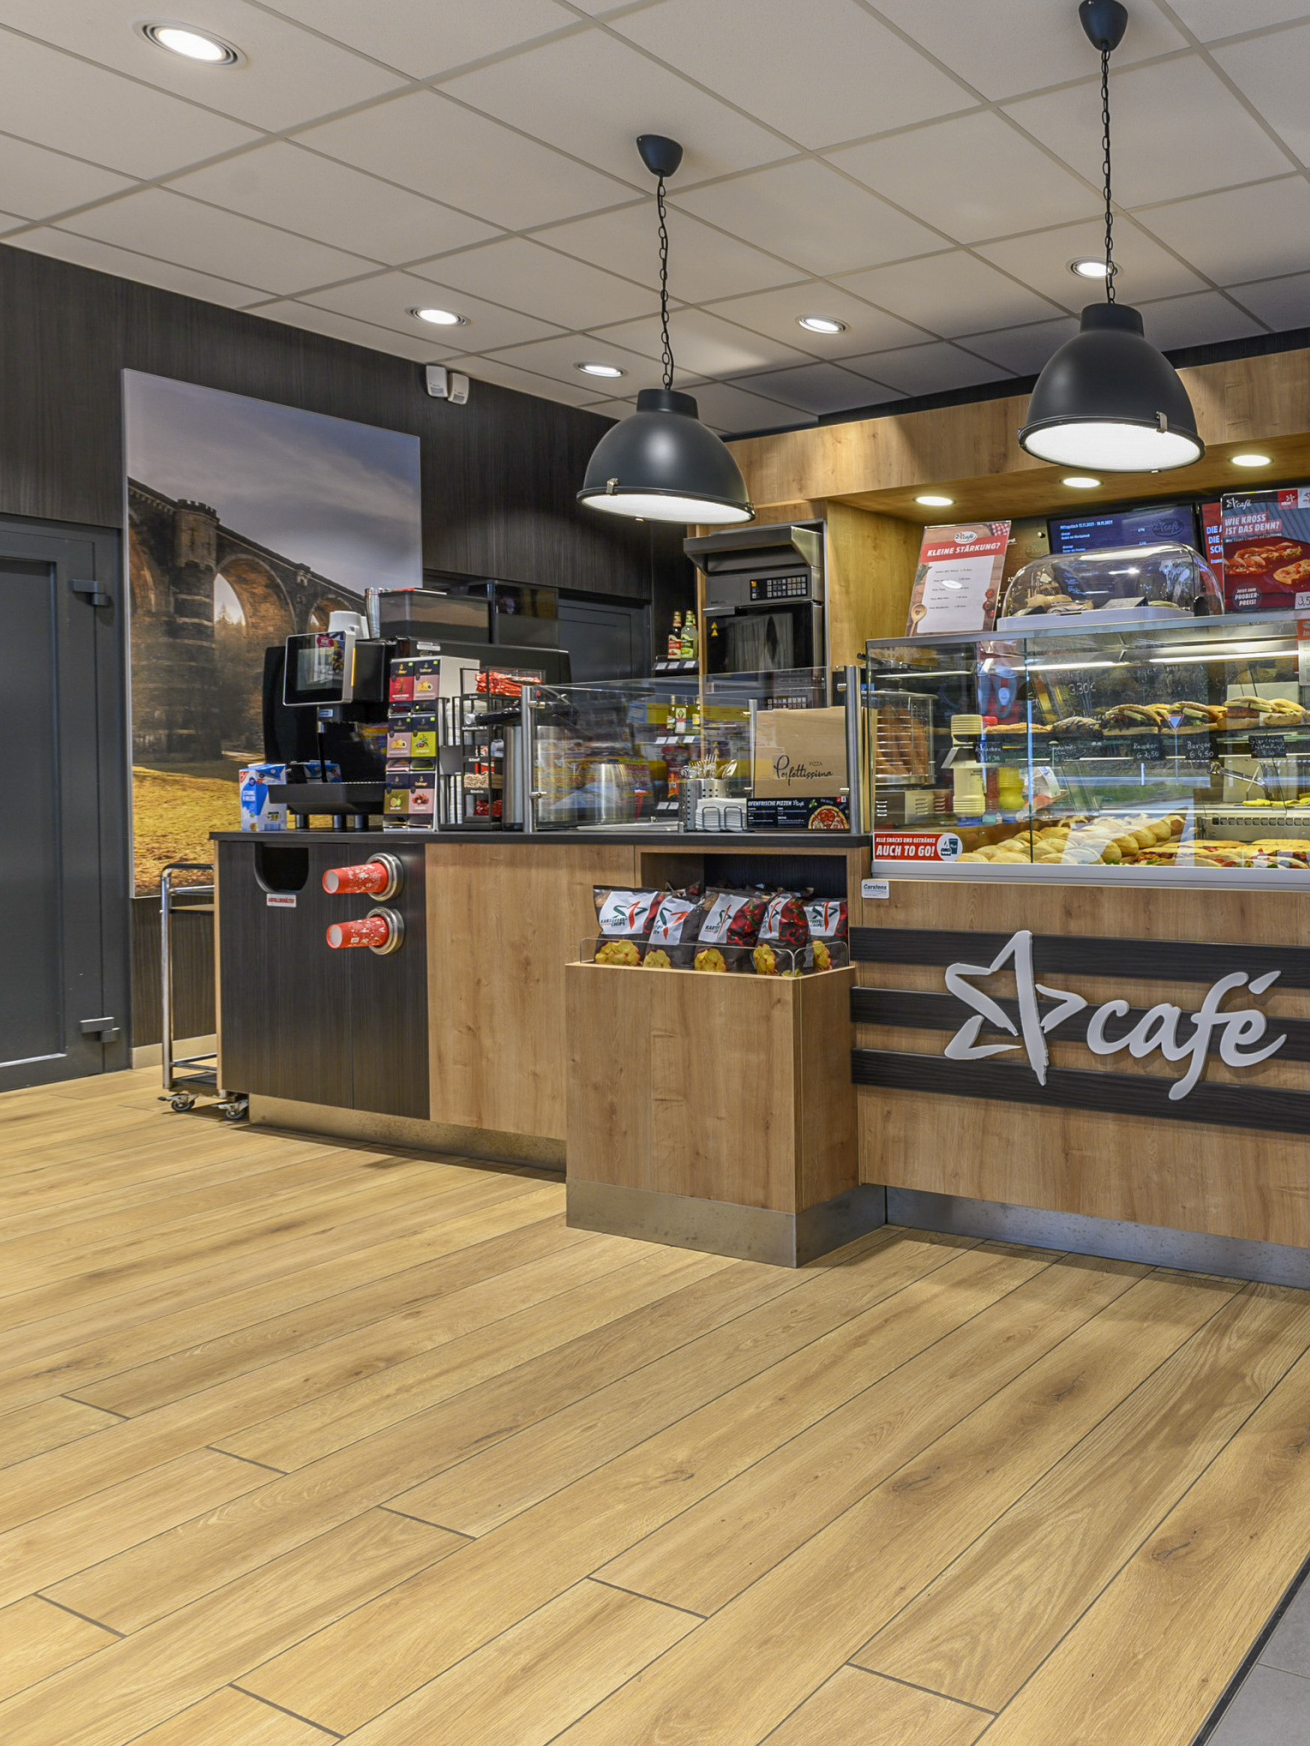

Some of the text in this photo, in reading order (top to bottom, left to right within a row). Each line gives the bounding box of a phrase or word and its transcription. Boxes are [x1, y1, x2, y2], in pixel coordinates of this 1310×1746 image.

[1225, 513, 1266, 527] WIE KROSS
[1206, 525, 1218, 535] DIE
[1225, 521, 1281, 536] IST DAS DENN?
[1208, 535, 1220, 545] DIE
[927, 542, 1001, 557] KLEINE STÄRKUNG?
[913, 836, 936, 844] GETRÄNKE
[876, 844, 936, 857] AUCH TO GO!
[1086, 969, 1288, 1102] café
